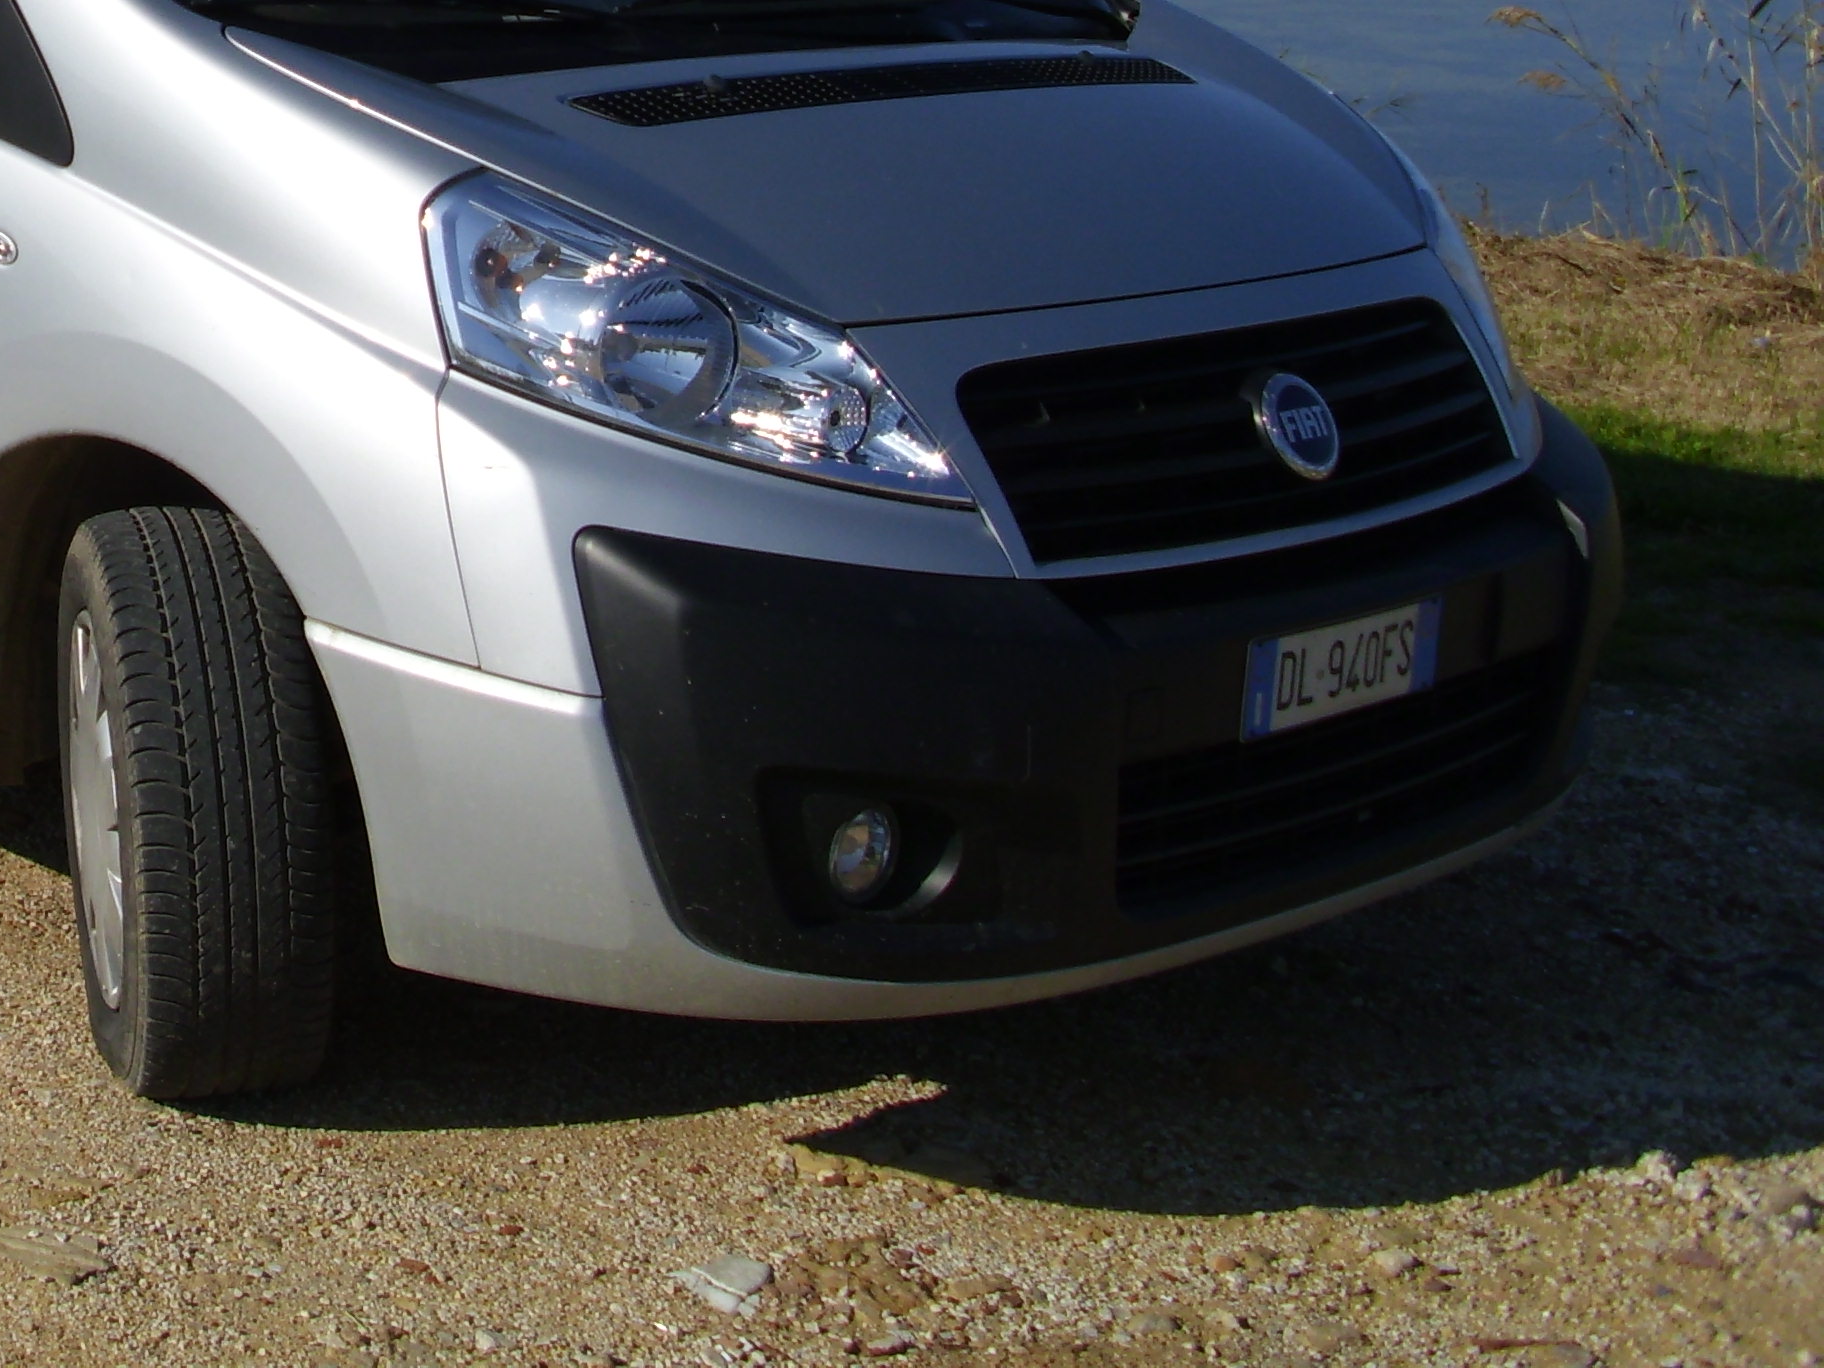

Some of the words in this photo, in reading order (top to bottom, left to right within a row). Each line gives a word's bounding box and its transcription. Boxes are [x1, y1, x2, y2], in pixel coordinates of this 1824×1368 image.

[1280, 405, 1328, 442] FIAT
[1277, 648, 1313, 711] DL
[1328, 620, 1414, 698] 940FS
